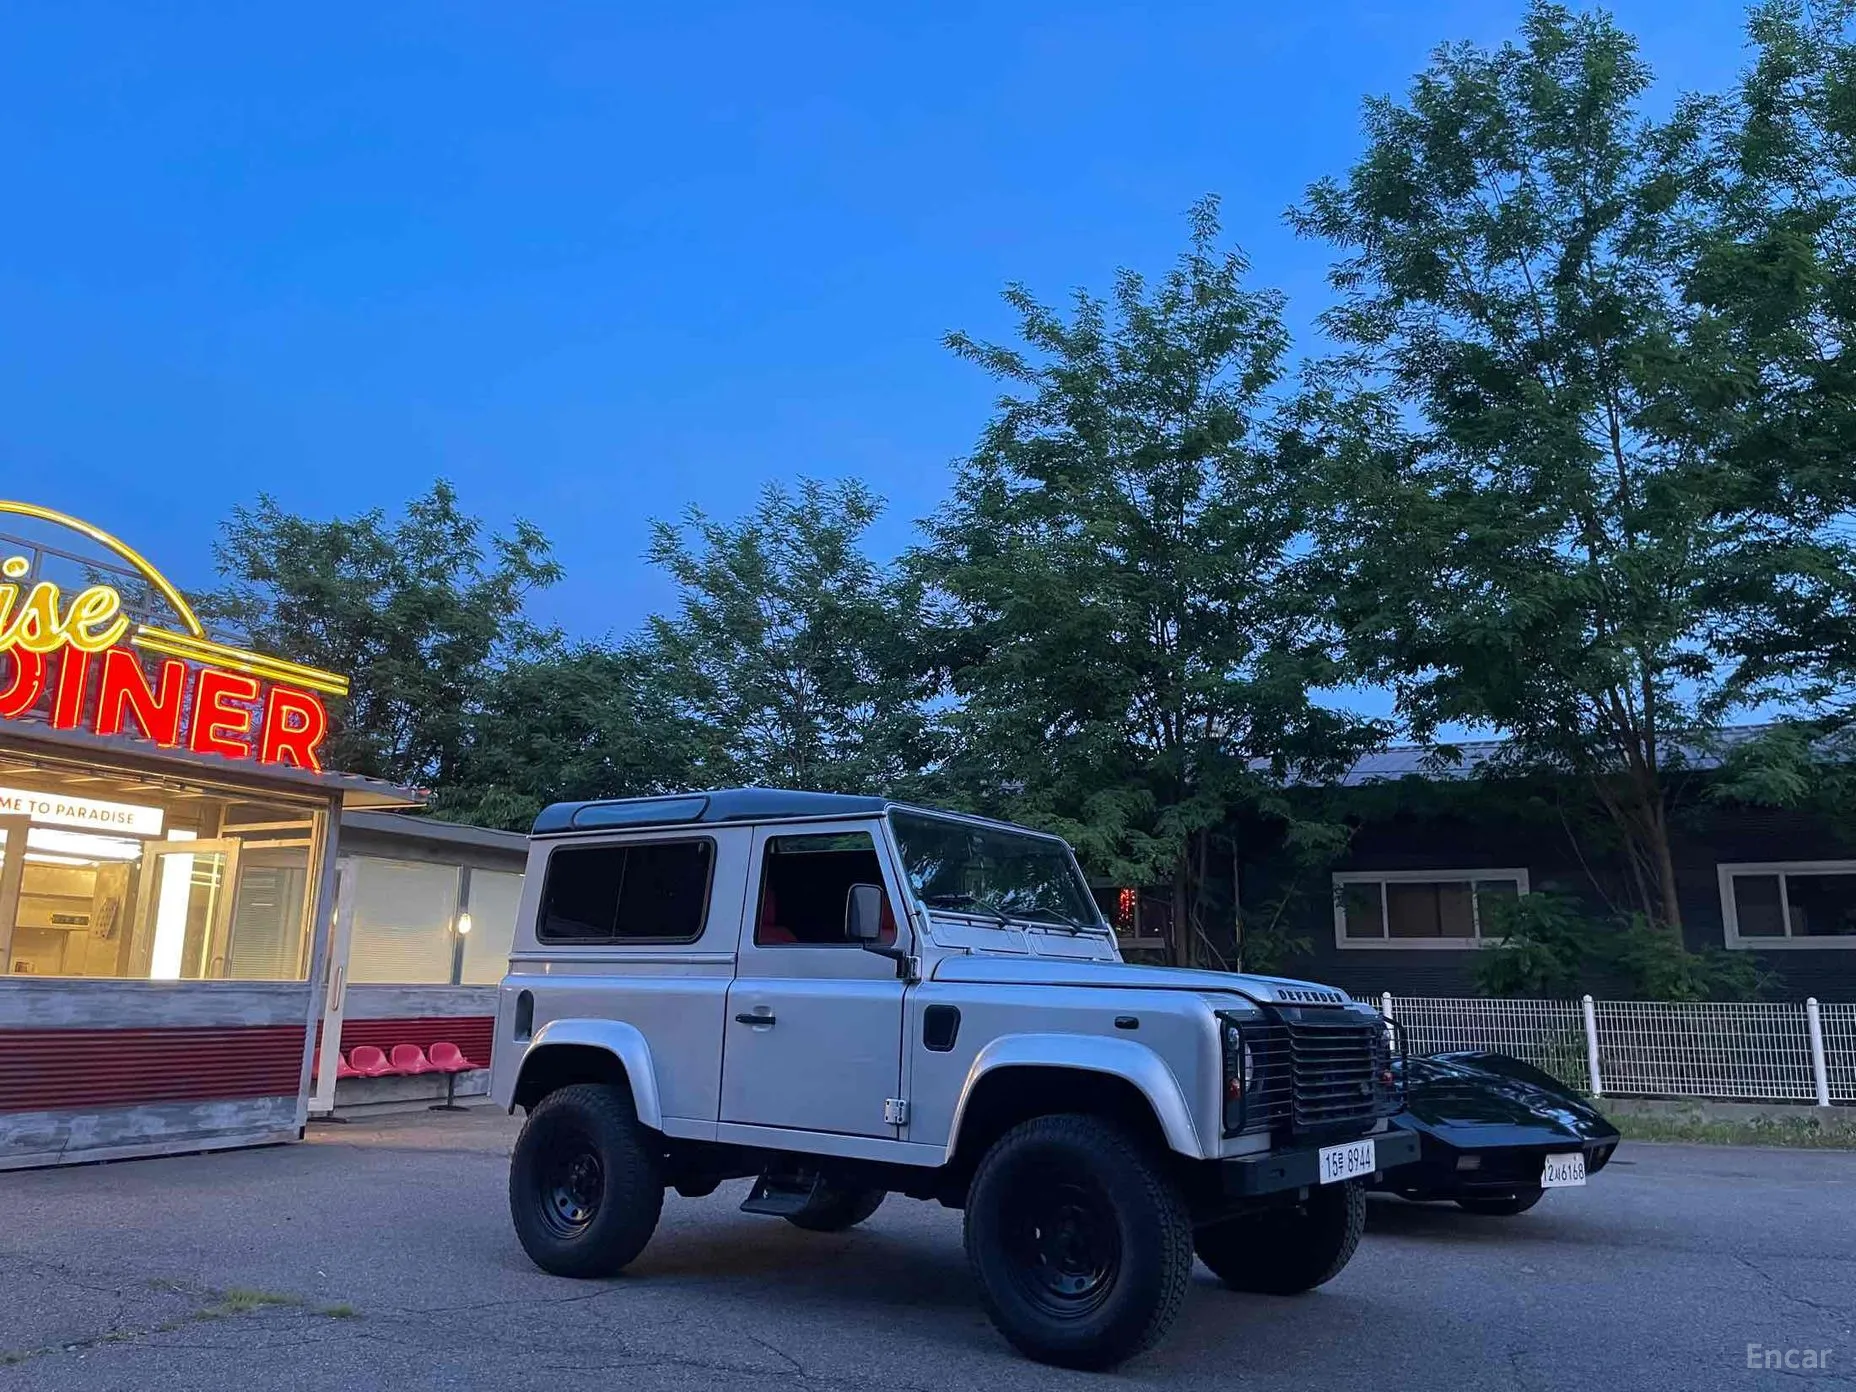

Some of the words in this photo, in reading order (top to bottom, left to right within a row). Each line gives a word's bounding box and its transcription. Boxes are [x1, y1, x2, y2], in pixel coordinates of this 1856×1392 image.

[28, 800, 50, 814] TO
[56, 804, 135, 824] PARADISE
[1277, 990, 1343, 1003] DEFENDER
[1347, 1145, 1371, 1173] 8944
